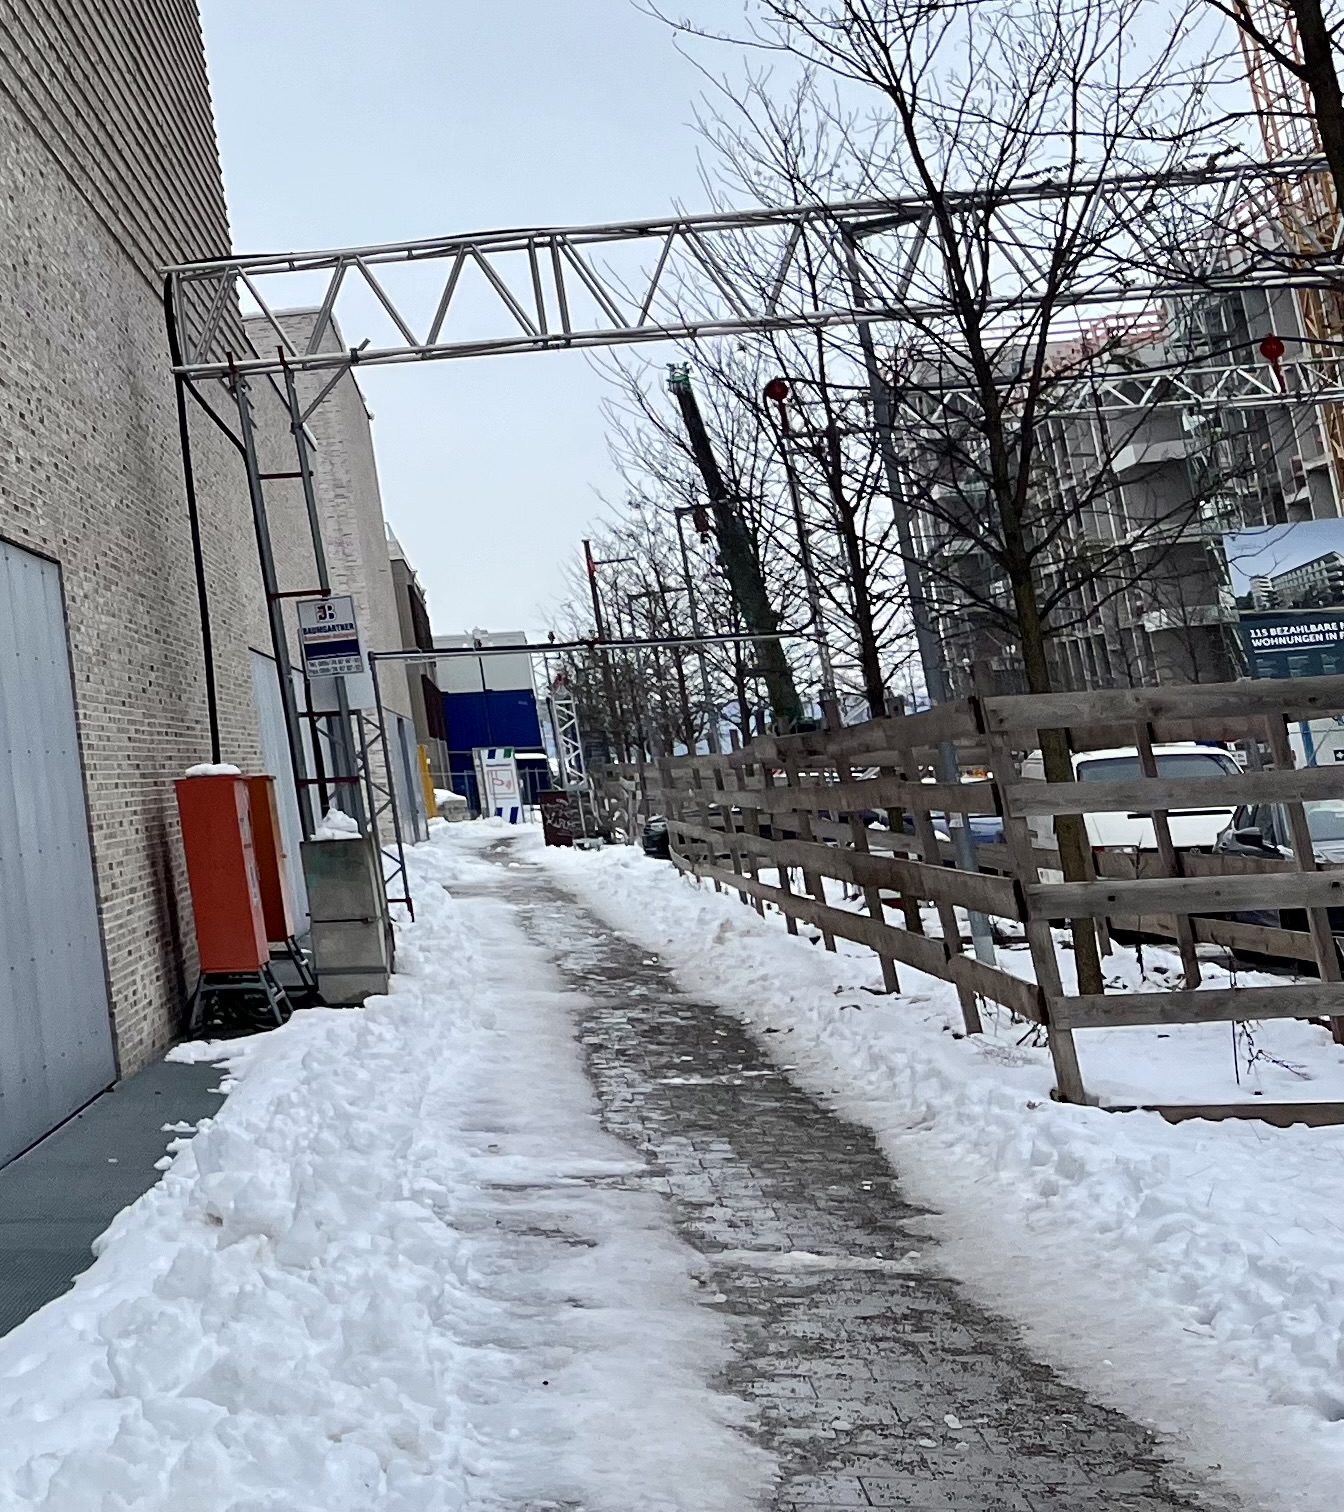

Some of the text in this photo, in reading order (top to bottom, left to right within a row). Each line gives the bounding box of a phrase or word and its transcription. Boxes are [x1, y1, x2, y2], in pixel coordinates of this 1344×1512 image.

[303, 623, 354, 635] BAUMGARTNER
[1250, 628, 1268, 638] 115
[1269, 622, 1338, 636] BEZAHLBARE
[1252, 633, 1324, 647] WOHNUNGEN
[1325, 632, 1338, 641] IN
